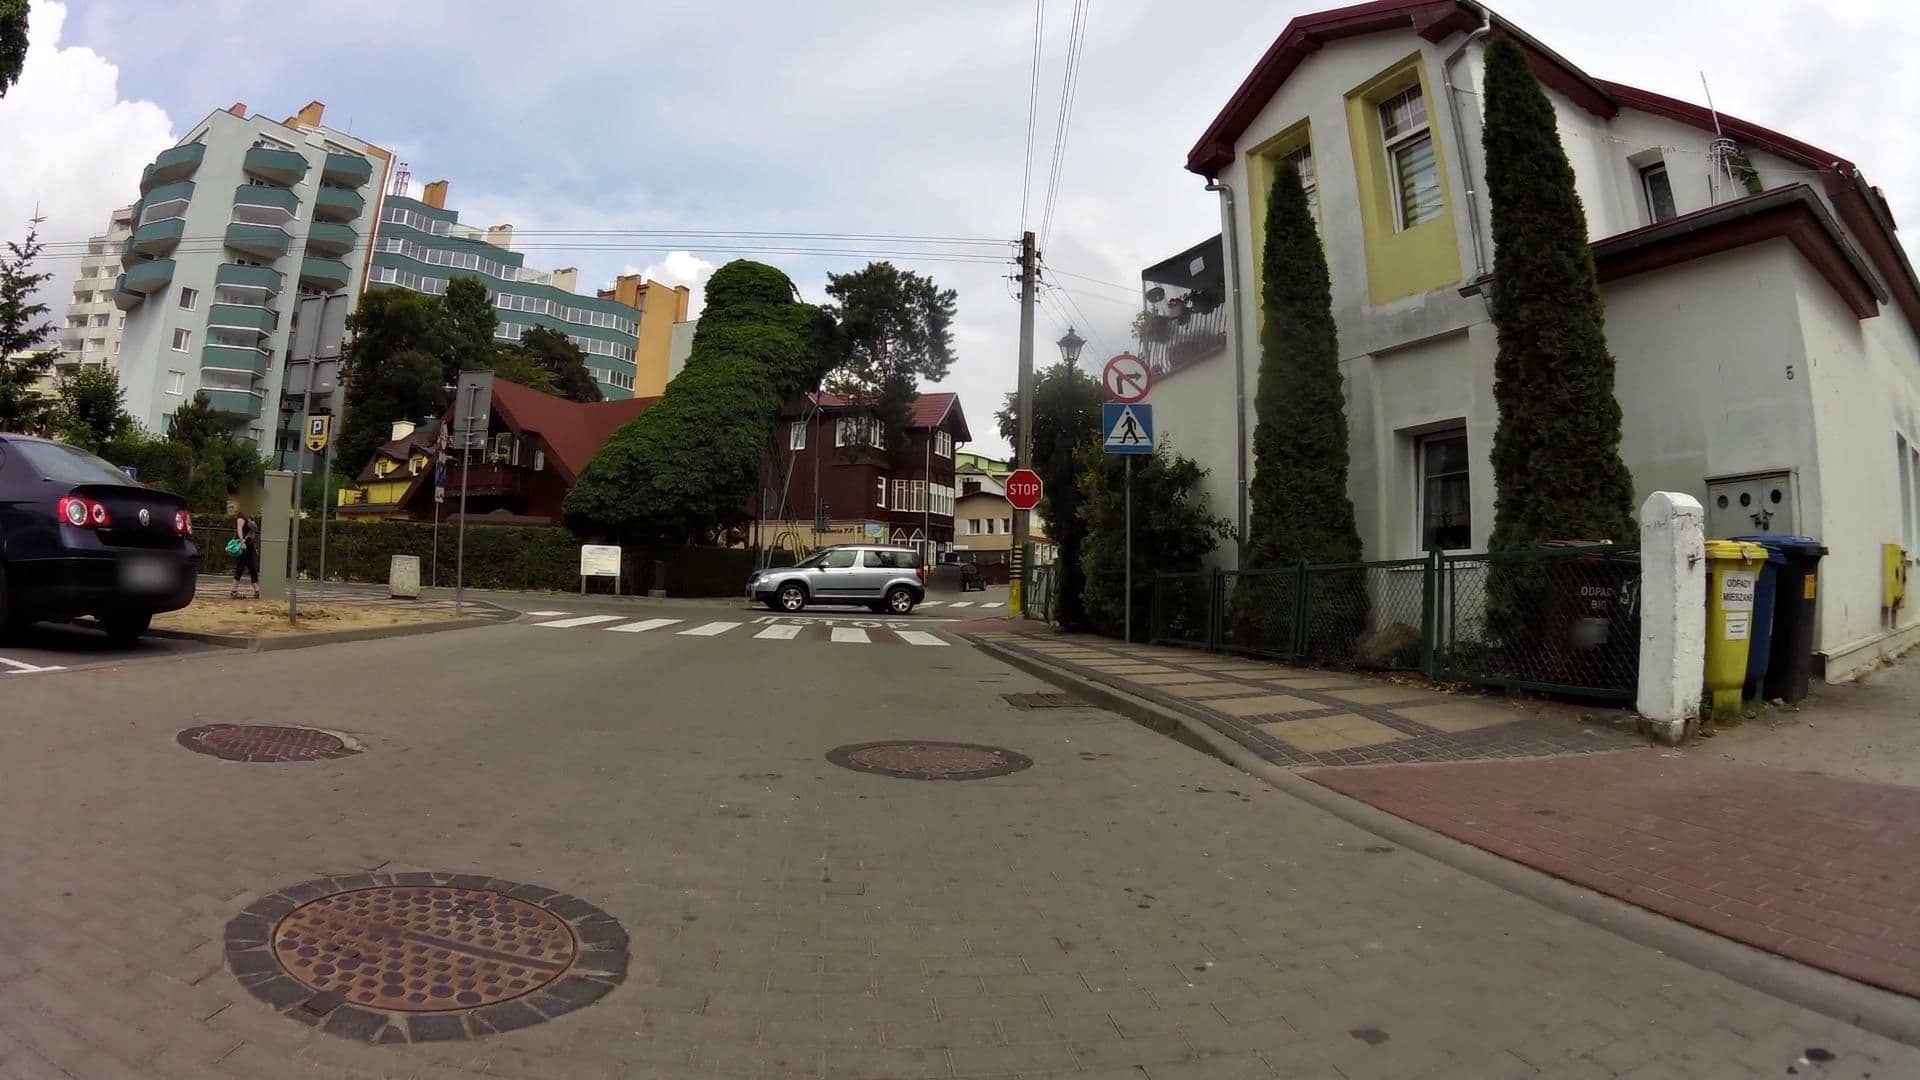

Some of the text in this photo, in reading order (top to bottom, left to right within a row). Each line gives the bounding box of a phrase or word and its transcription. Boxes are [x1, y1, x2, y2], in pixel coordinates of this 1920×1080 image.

[1785, 364, 1794, 380] 5
[313, 420, 322, 434] P
[1009, 483, 1039, 496] STOP
[1591, 599, 1607, 609] BIO
[789, 618, 910, 629] STOP
